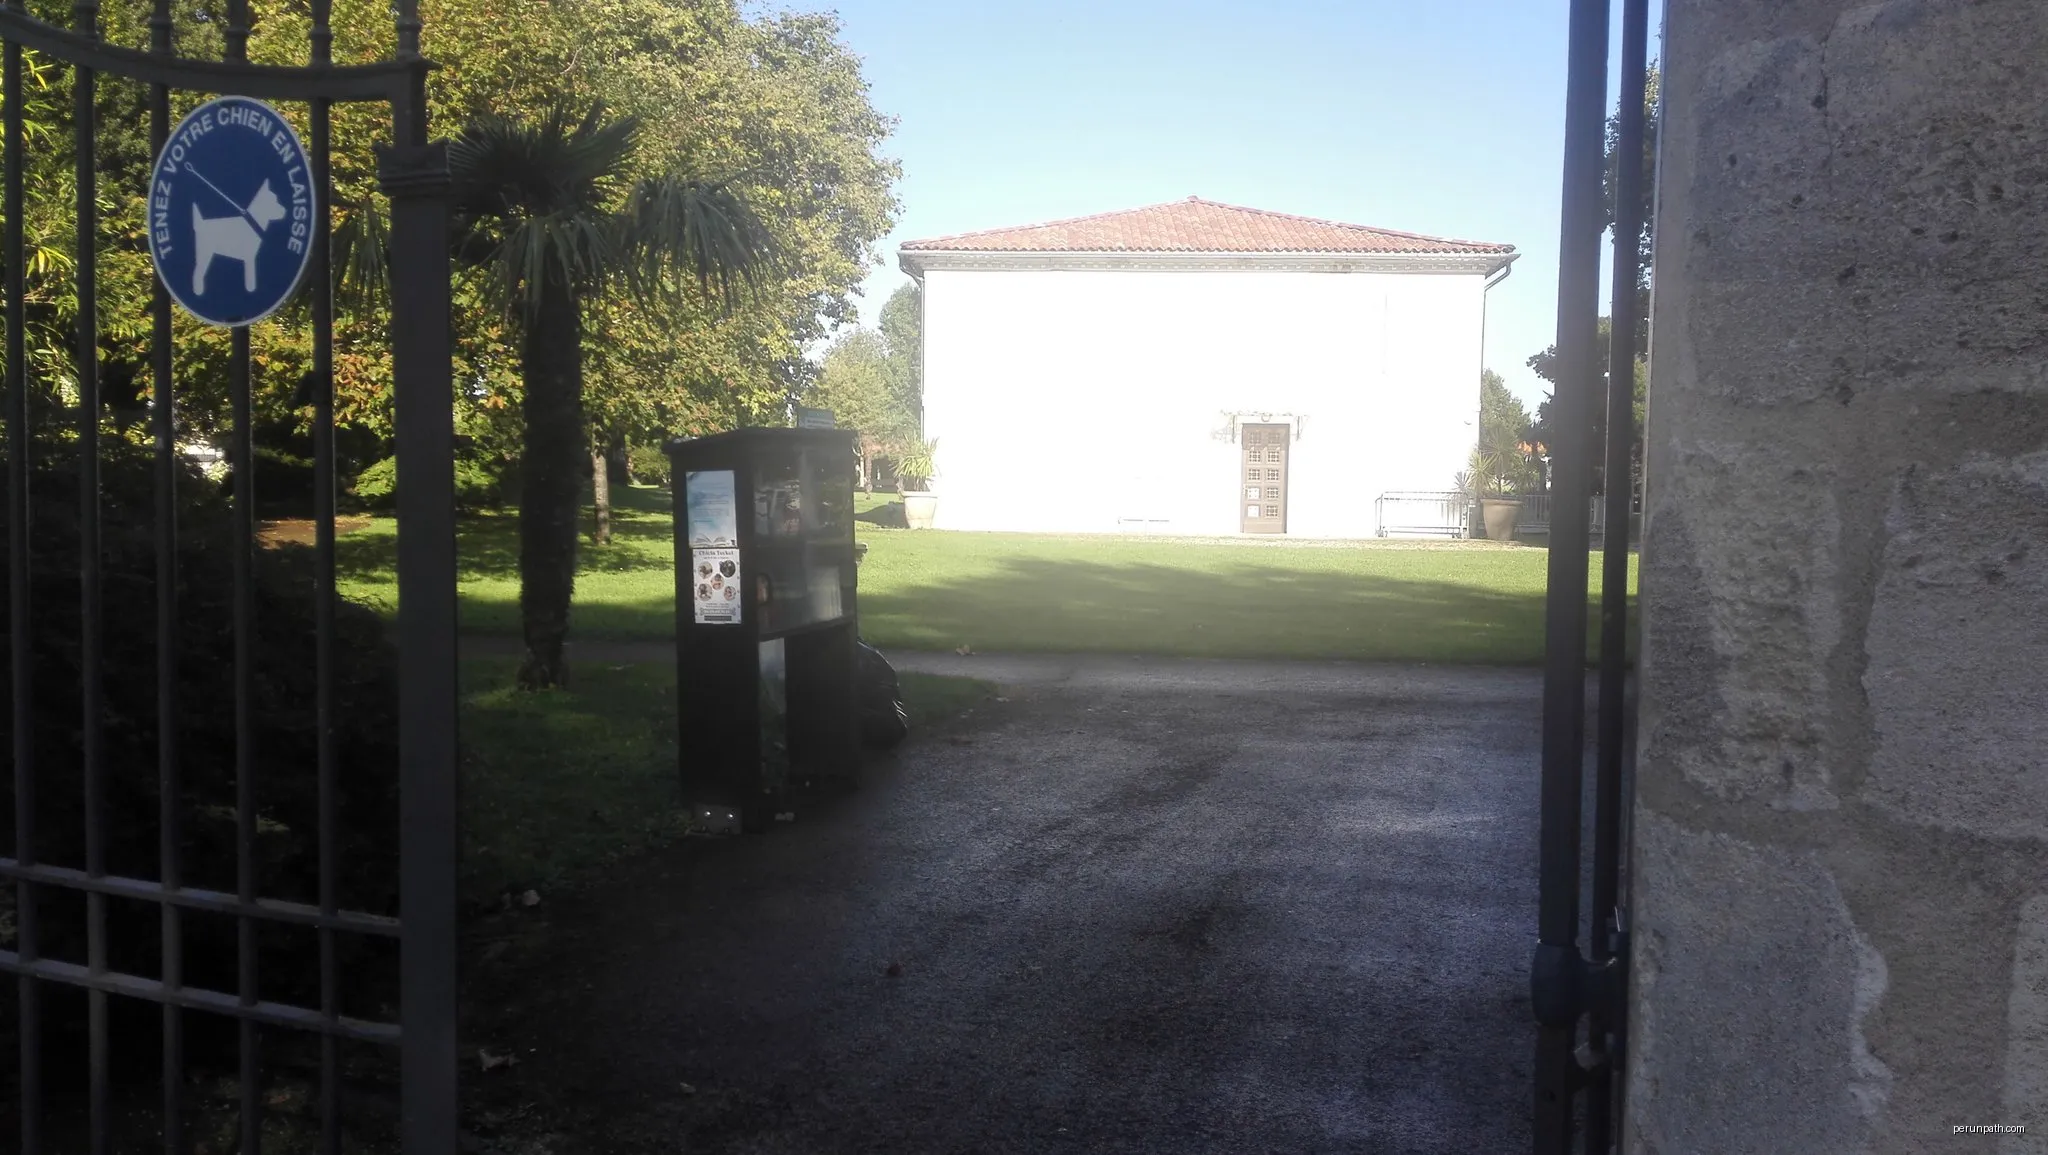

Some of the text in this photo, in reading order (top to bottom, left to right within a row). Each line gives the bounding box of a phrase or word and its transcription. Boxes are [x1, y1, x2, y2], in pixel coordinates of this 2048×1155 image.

[155, 106, 307, 260] TENEZ VOTRE CHIEN EN LAISSE
